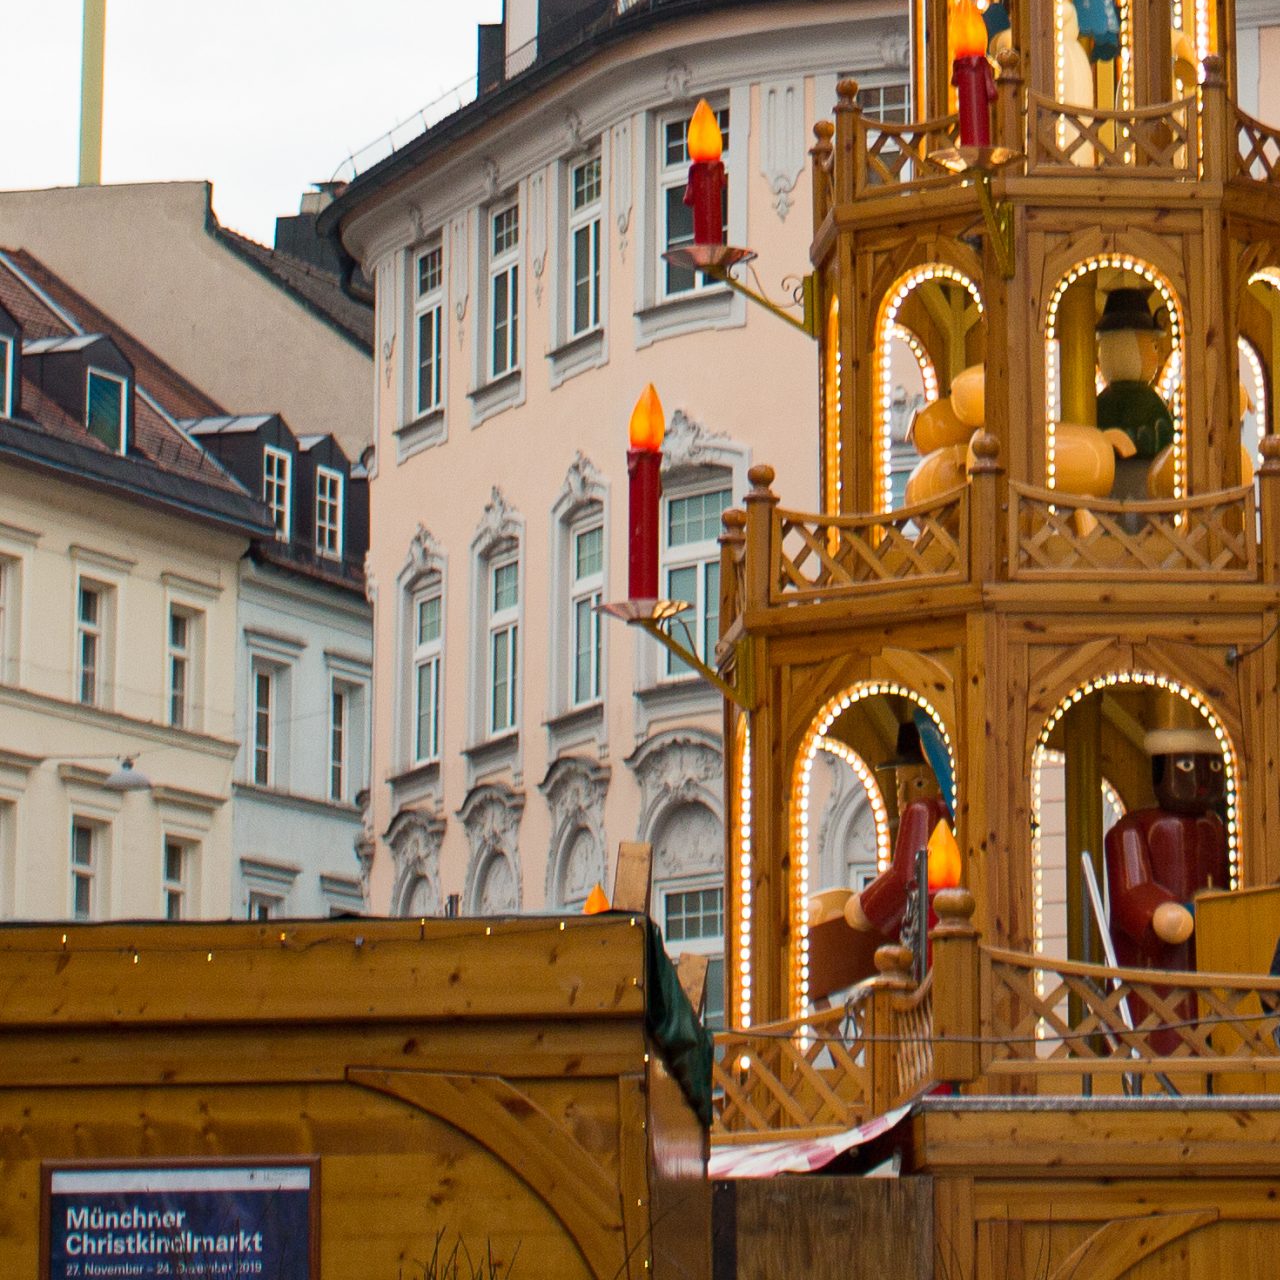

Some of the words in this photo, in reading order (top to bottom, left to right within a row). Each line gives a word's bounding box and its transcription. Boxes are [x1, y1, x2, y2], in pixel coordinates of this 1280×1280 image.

[66, 1206, 186, 1230] Münchner
[66, 1230, 263, 1255] Christkindlmarkt
[84, 1262, 143, 1276] November
